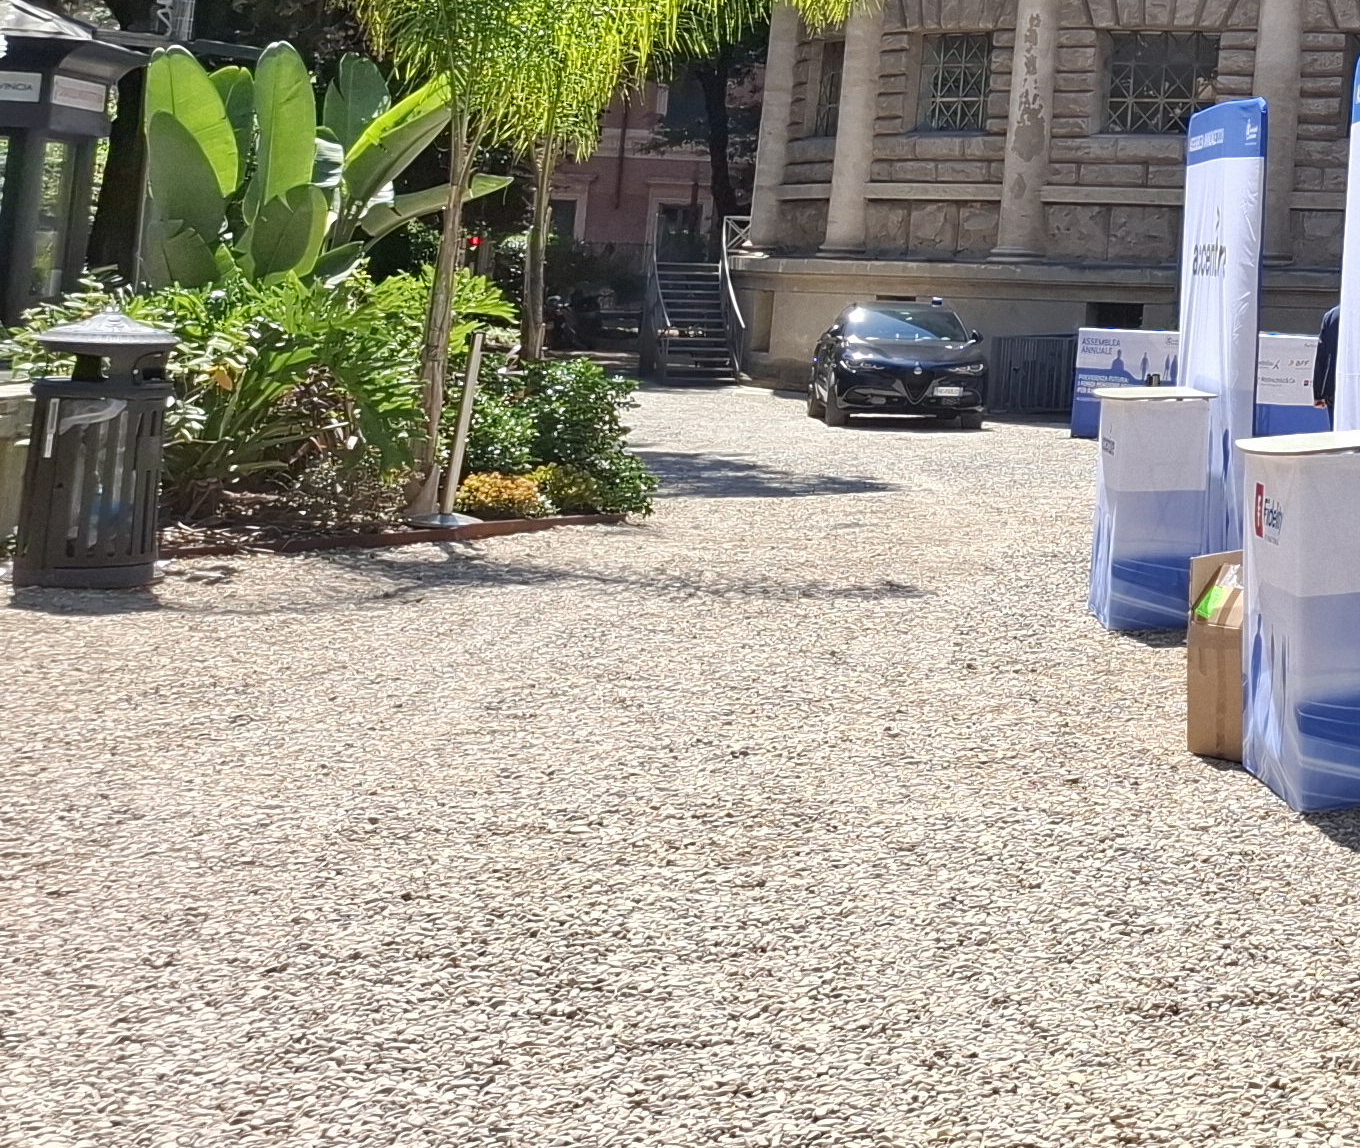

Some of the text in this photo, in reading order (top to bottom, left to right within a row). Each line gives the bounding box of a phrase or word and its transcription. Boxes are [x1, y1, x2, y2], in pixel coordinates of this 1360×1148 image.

[1081, 337, 1121, 347] ASSEMBLEA
[1081, 345, 1113, 356] ANNUALE
[1263, 497, 1285, 536] Fidelity
